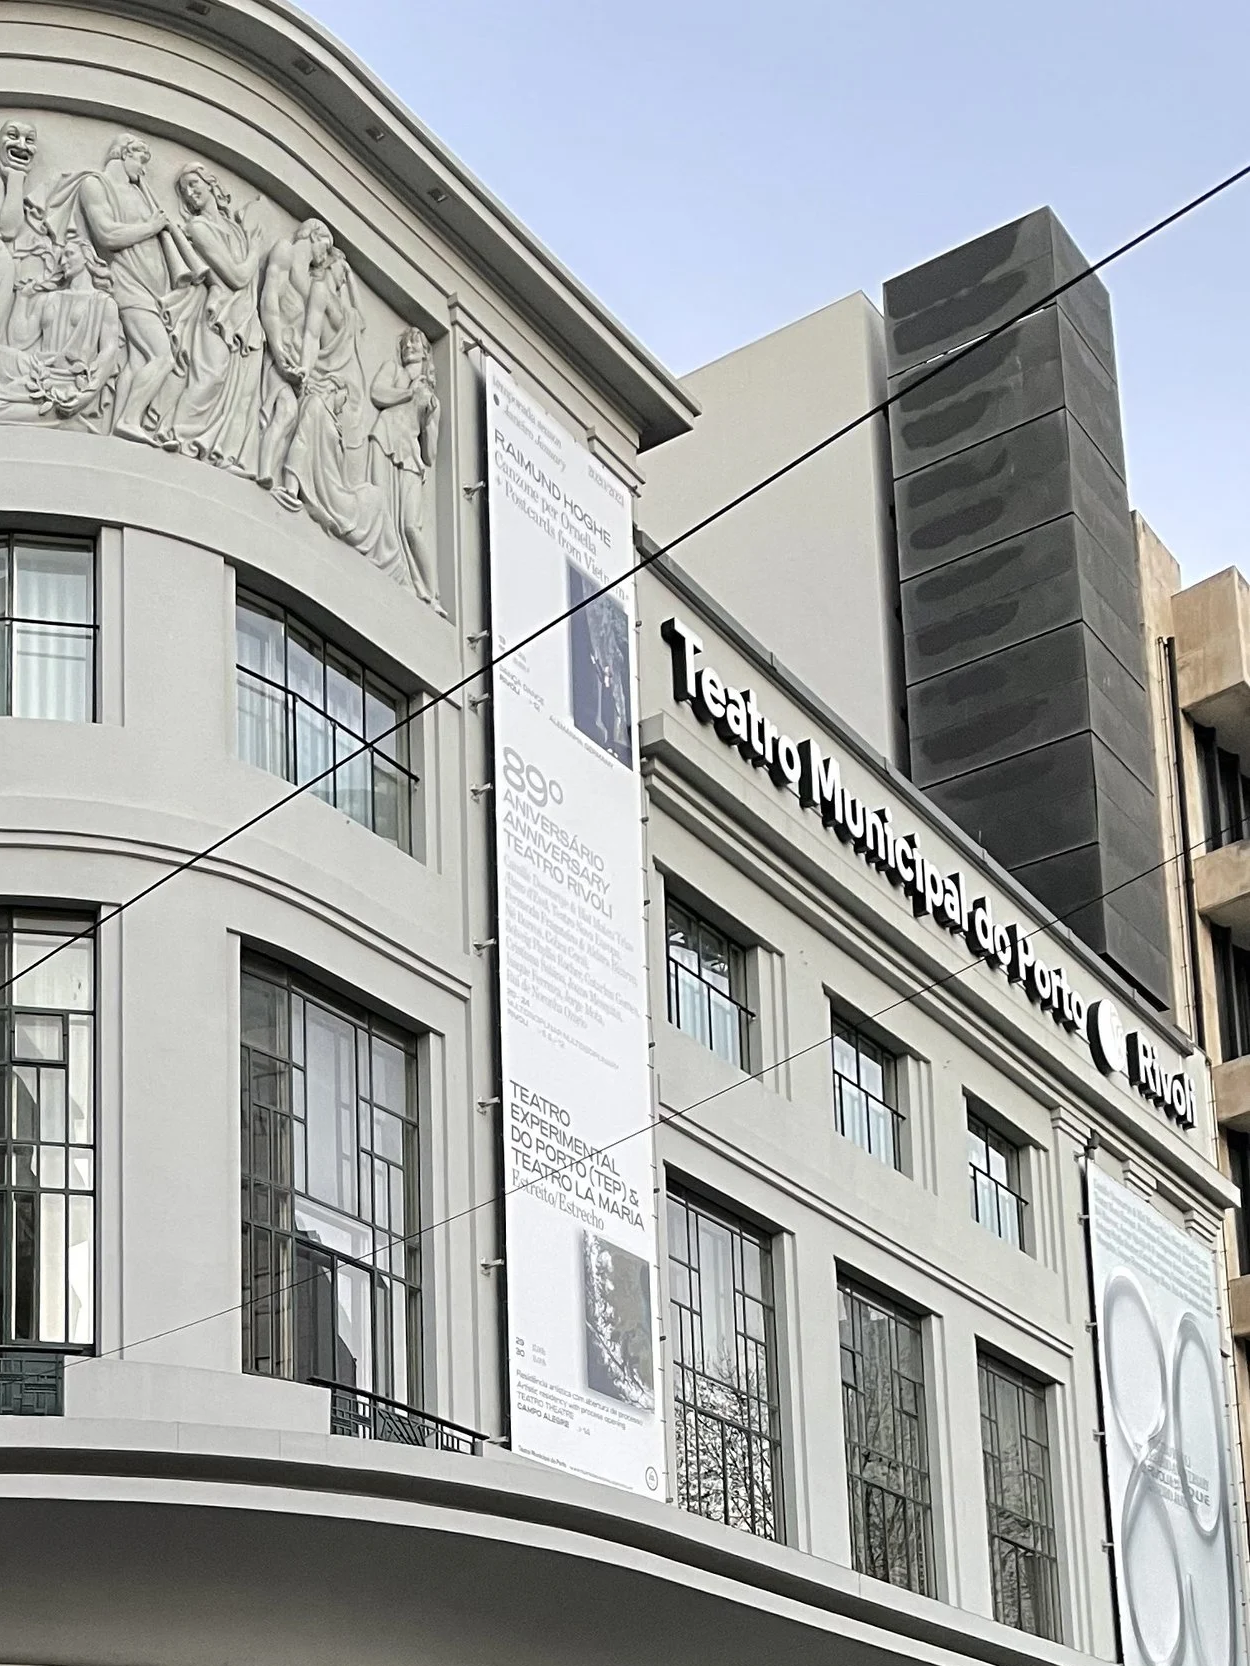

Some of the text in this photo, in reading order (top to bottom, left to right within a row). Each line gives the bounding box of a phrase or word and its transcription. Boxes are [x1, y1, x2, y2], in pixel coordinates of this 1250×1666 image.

[495, 429, 612, 548] RAIMUND HOGHE
[495, 451, 597, 556] Canzone per Ornella
[505, 480, 556, 538] Postcards
[558, 529, 582, 562] from
[503, 789, 605, 872] ANIVERSÁRIO
[503, 811, 610, 896] ANNIVERSARY
[503, 828, 564, 884] TEATRO
[568, 876, 612, 920] RIVOLI
[664, 617, 1198, 1129] Teatro Municipal do Porto Rivoli
[510, 1079, 570, 1127] TEATRO
[511, 1103, 620, 1176] EXPERIMENTAL
[511, 1124, 639, 1207] DO PORTO (TEP) &
[511, 1147, 645, 1231] TEATRO LA MARIA
[512, 1168, 604, 1231] Estreito/Estrecho
